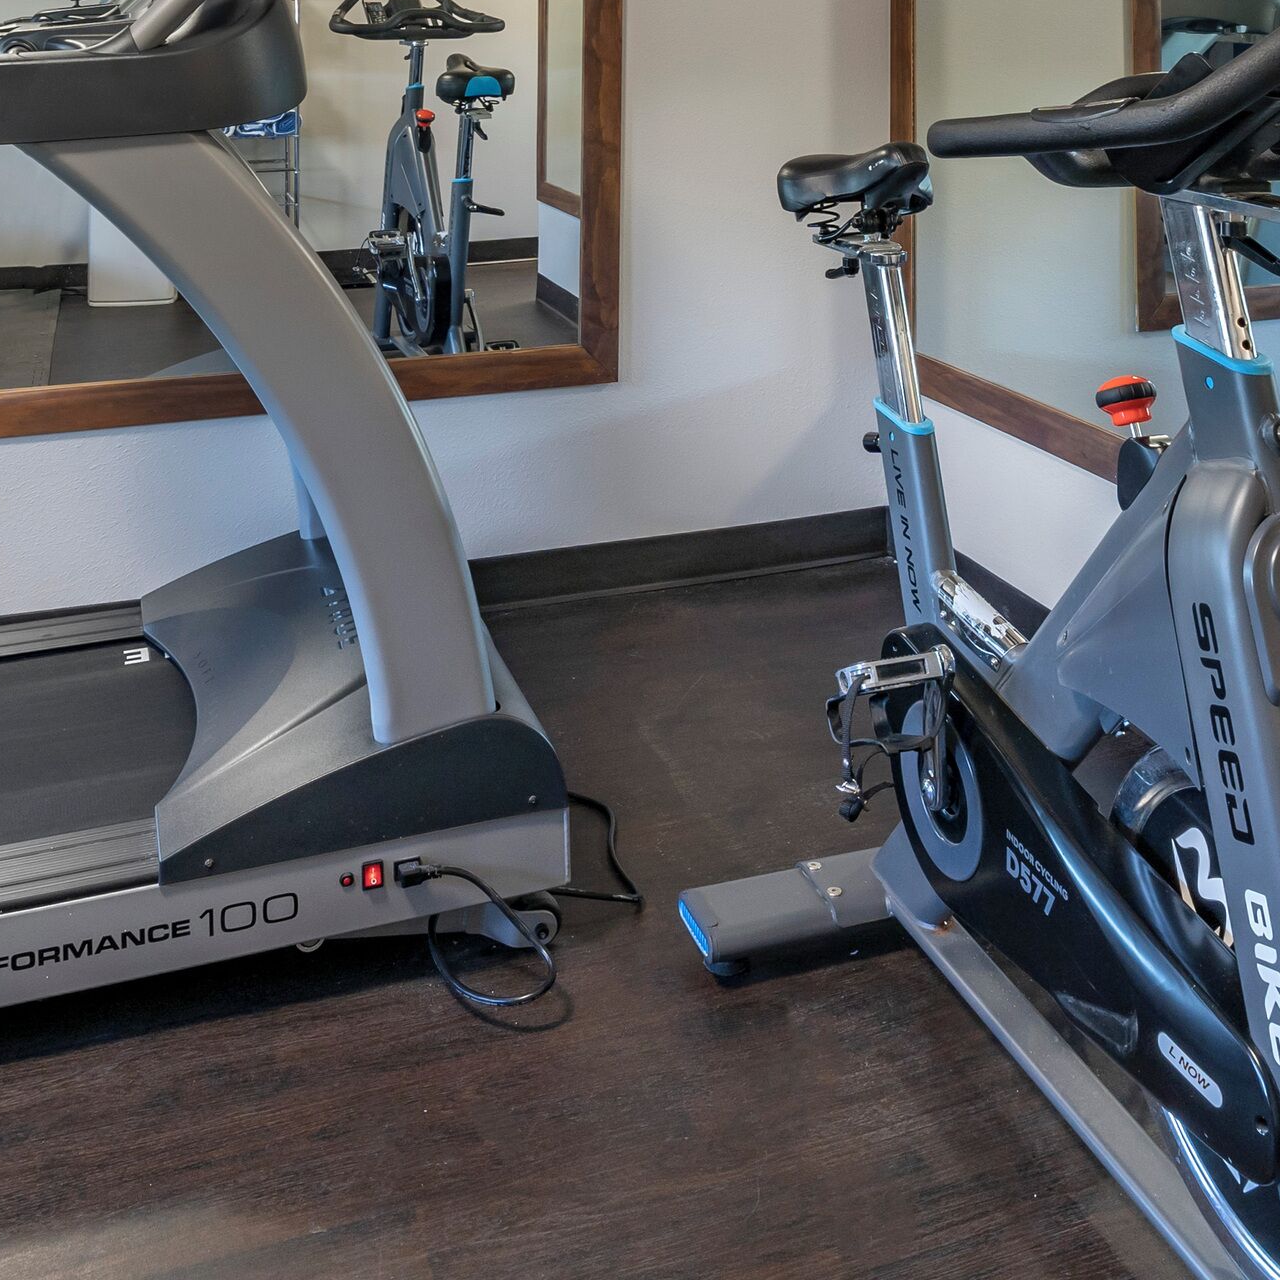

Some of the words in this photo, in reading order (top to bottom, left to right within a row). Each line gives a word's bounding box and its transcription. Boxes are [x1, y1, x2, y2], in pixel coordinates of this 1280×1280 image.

[890, 449, 907, 509] LIVE
[900, 514, 911, 541] IN
[904, 546, 922, 615] NOW
[1192, 601, 1255, 846] SPEED
[1006, 828, 1035, 866] INDOOR
[1035, 860, 1069, 901] CYCLING
[1006, 846, 1056, 916] D577
[199, 892, 299, 938] 100
[1168, 1046, 1176, 1059] L
[1178, 1056, 1210, 1090] NOW
